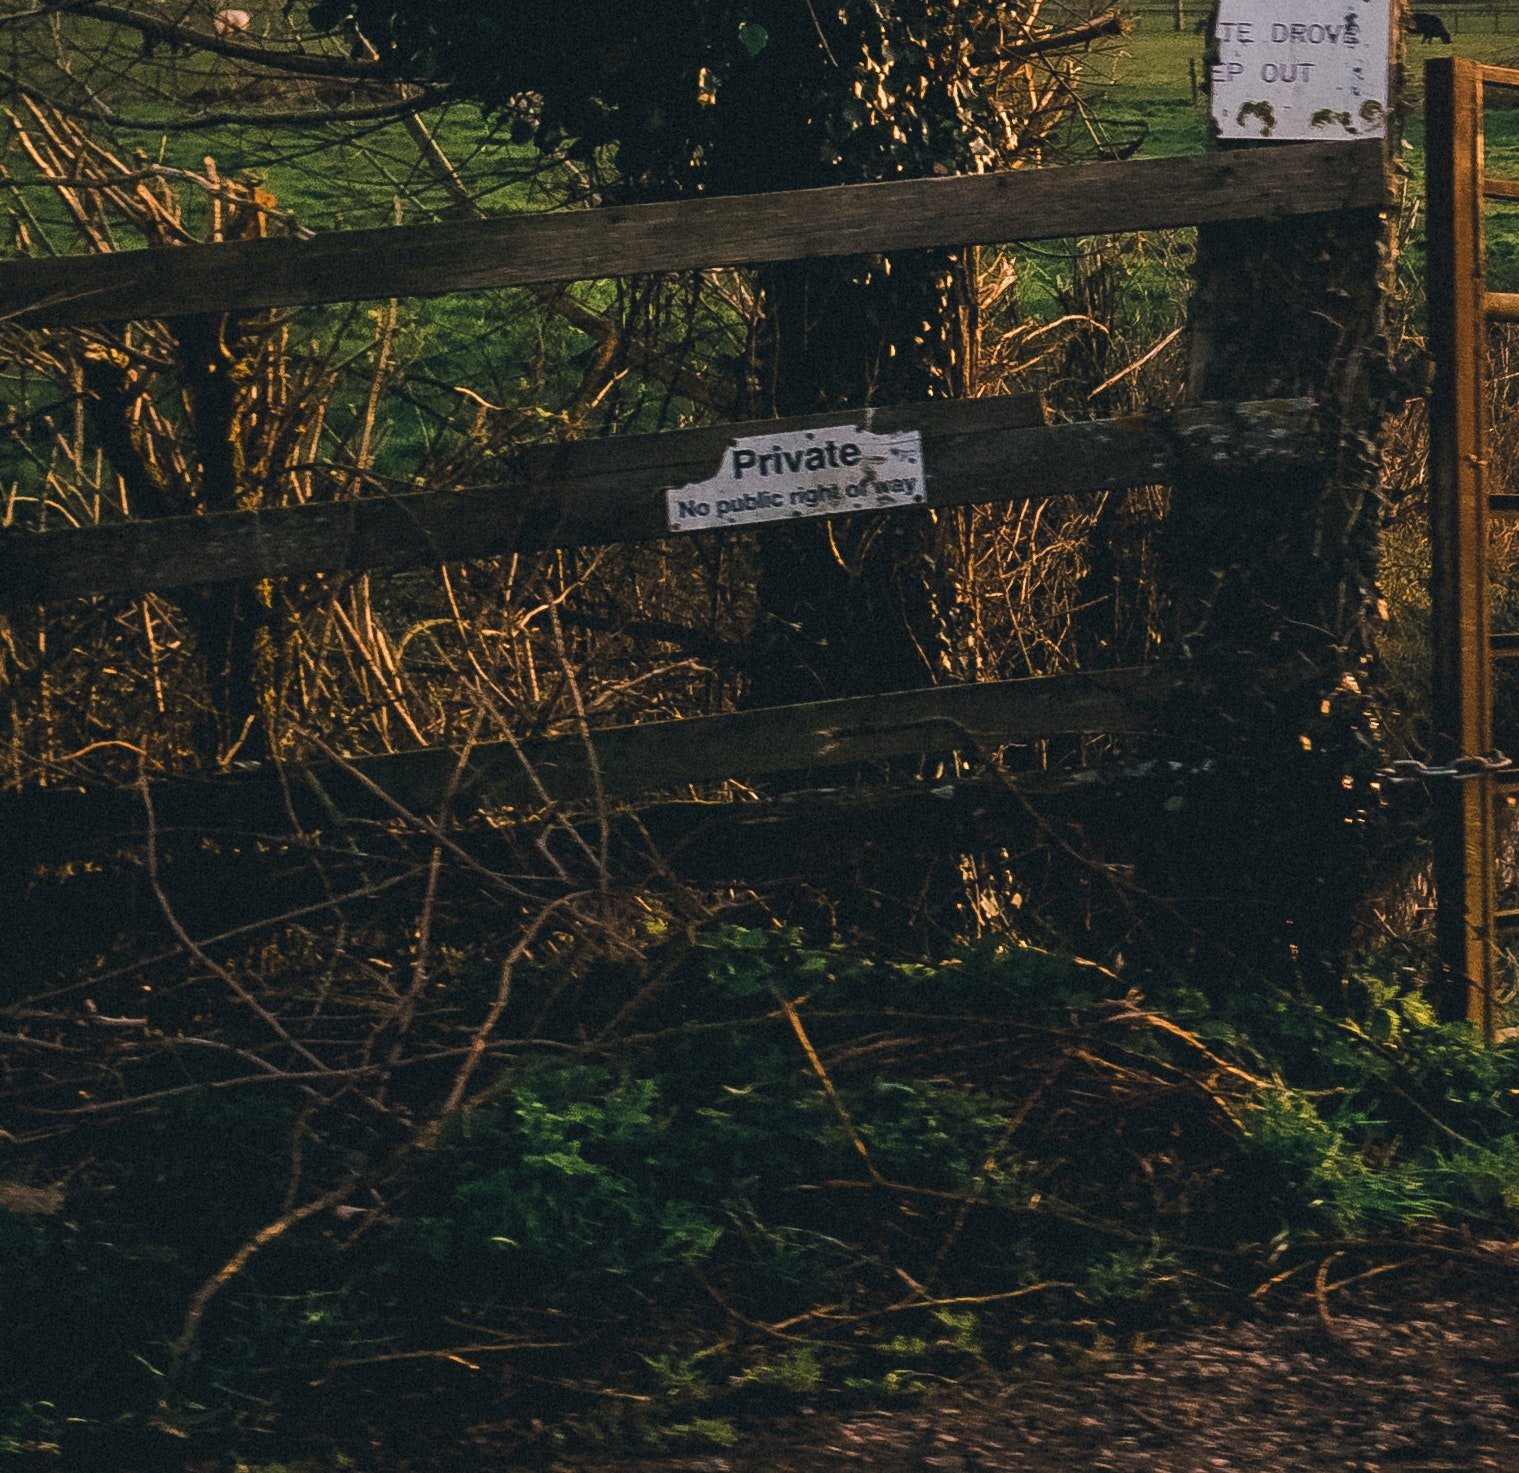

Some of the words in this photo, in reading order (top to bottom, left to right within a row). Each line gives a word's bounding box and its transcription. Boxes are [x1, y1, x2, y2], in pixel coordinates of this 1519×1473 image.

[1271, 22, 1360, 44] DROVE
[1261, 63, 1316, 83] OUT
[733, 441, 862, 479] Private
[677, 499, 710, 519] No
[716, 491, 783, 518] public
[789, 484, 840, 507] right
[872, 478, 918, 497] way
